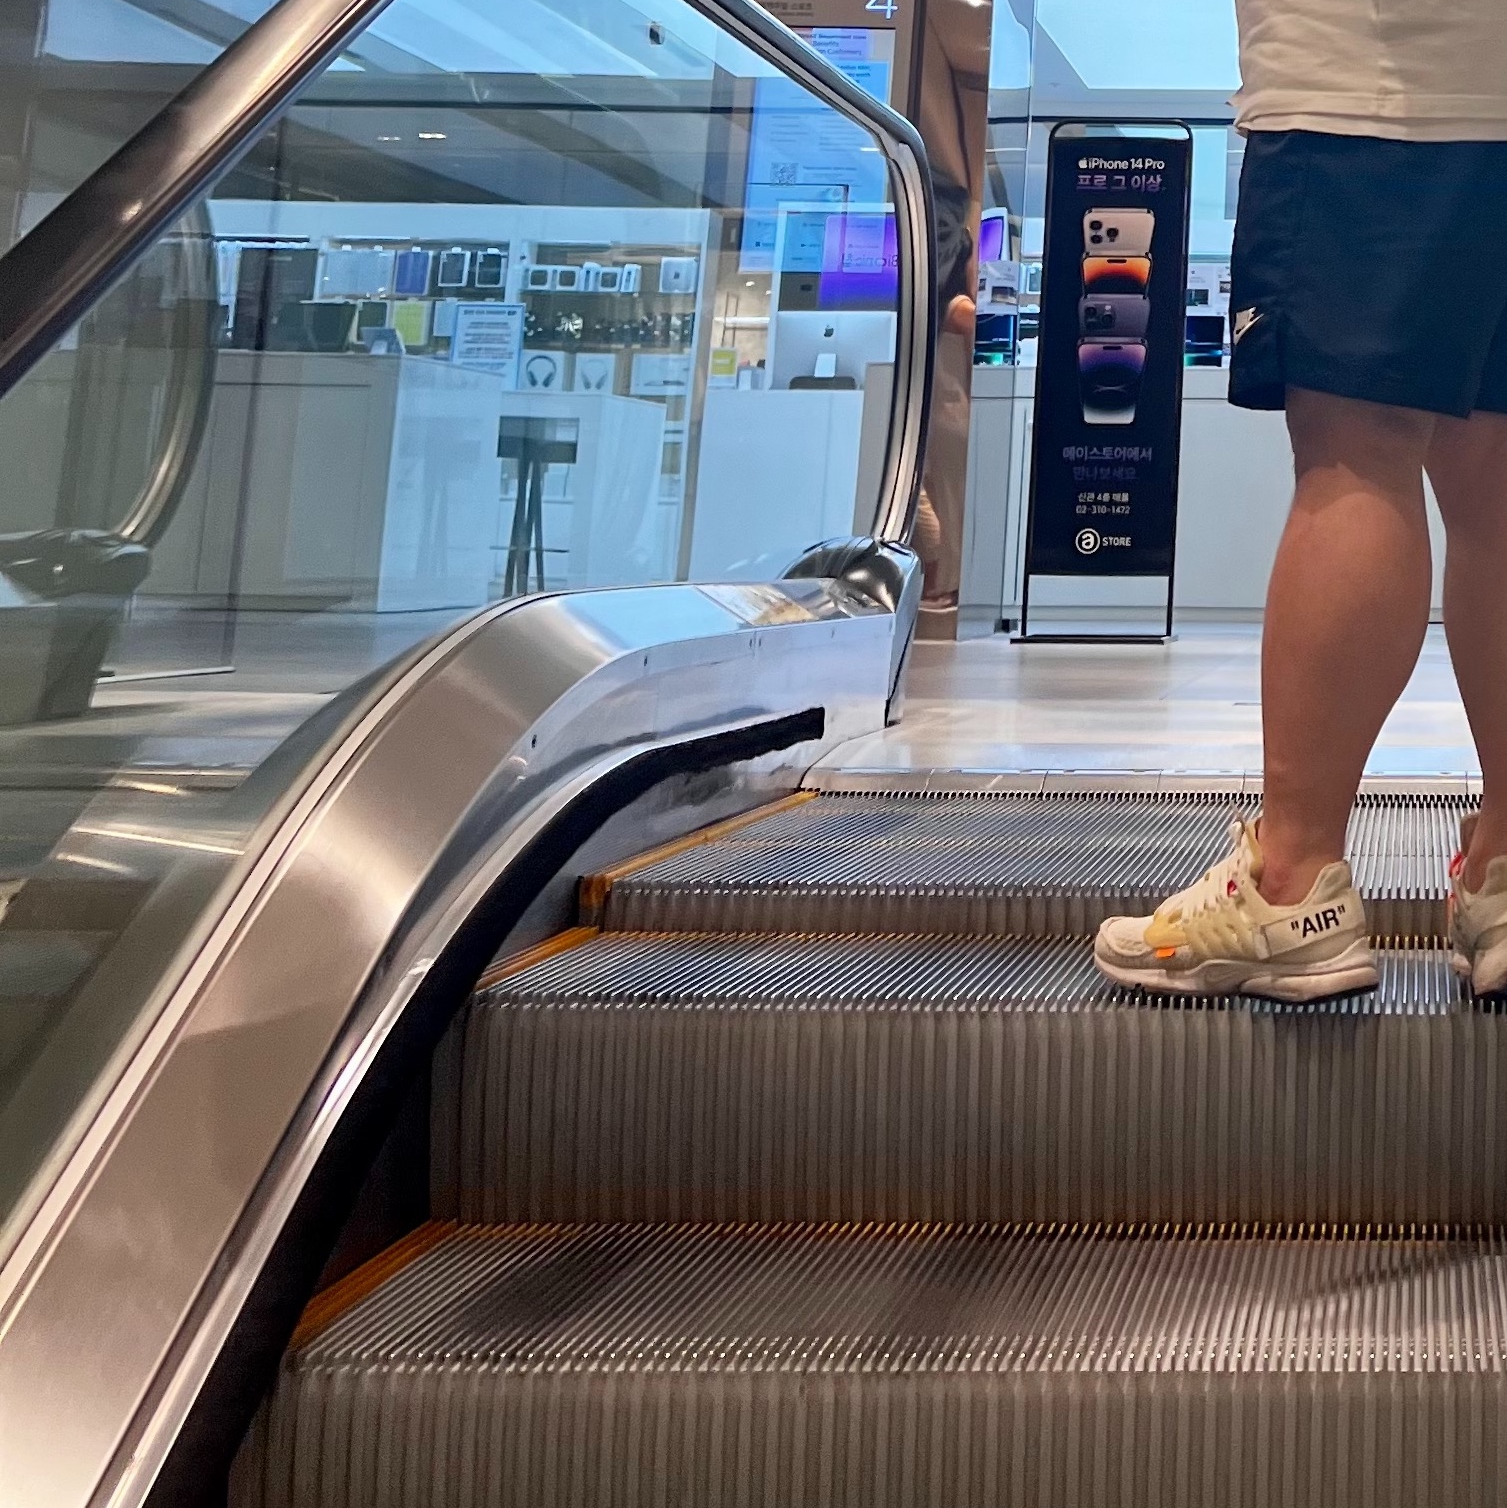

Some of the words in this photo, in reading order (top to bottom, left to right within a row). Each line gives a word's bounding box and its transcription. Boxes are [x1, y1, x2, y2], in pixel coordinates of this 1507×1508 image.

[1088, 158, 1129, 170] iPhone
[1130, 158, 1143, 170] 14
[1144, 158, 1165, 170] Pro
[1076, 174, 1107, 190] 프로
[1110, 175, 1127, 190] 그
[1102, 537, 1132, 546] STORE
[1290, 903, 1347, 939] "AIR"
